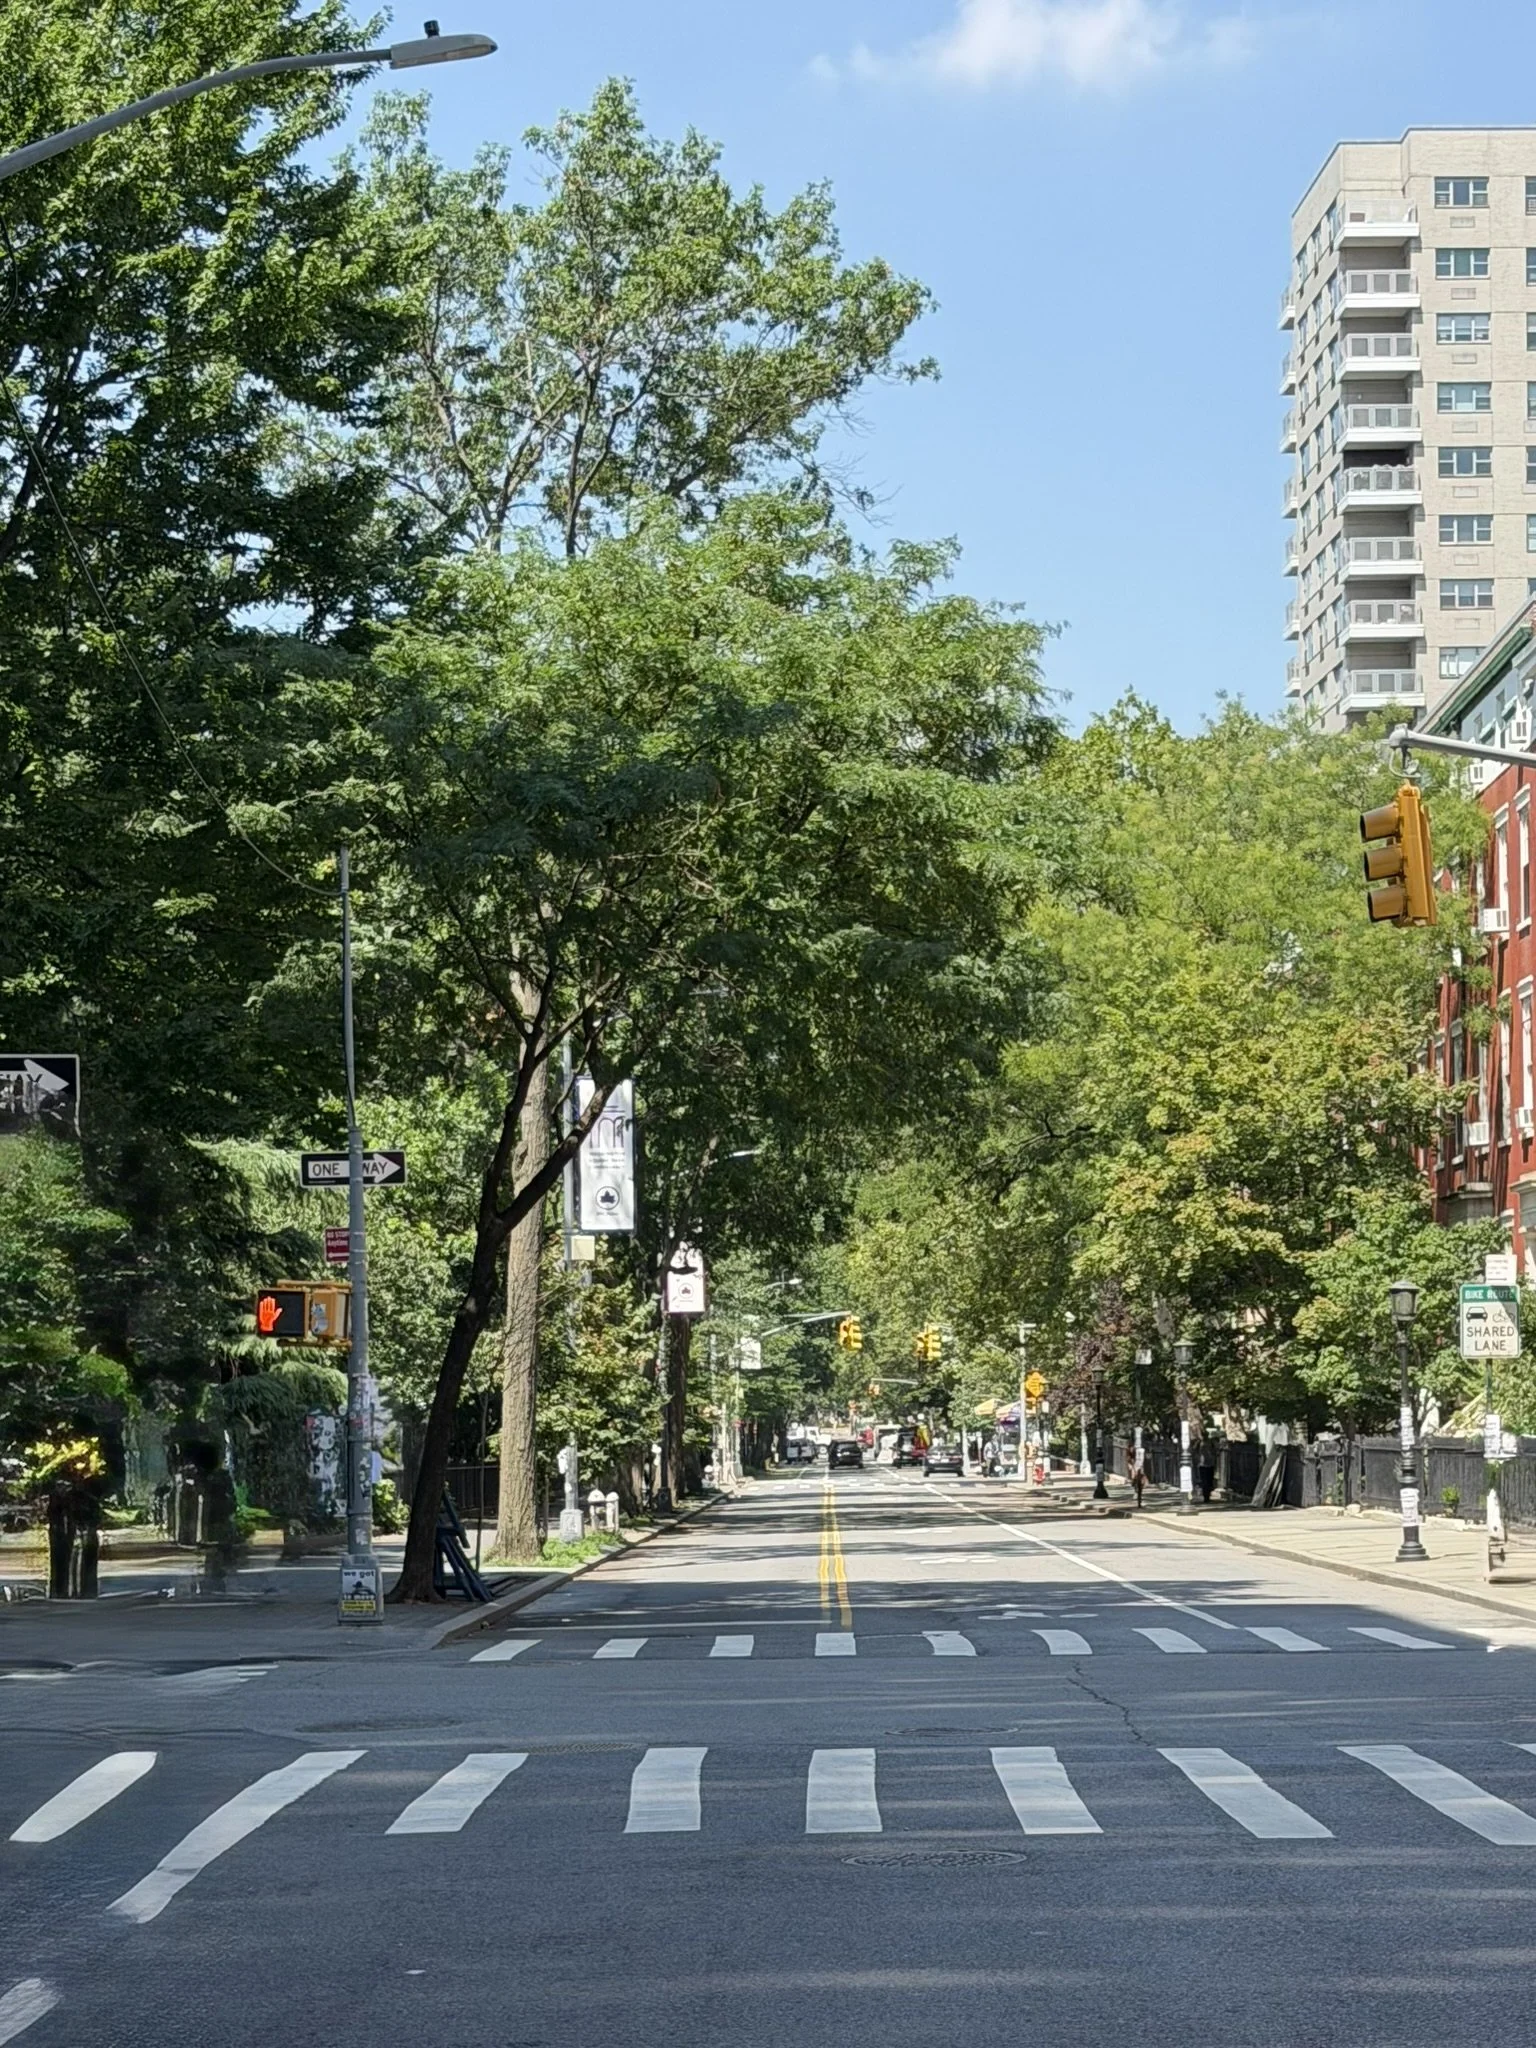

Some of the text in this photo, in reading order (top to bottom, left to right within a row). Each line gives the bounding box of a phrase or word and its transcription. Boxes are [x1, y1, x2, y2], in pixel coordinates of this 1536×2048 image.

[312, 1163, 340, 1176] ONE
[1465, 1289, 1484, 1299] BIKE
[1467, 1326, 1514, 1337] SHARED
[1475, 1340, 1506, 1351] LANE
